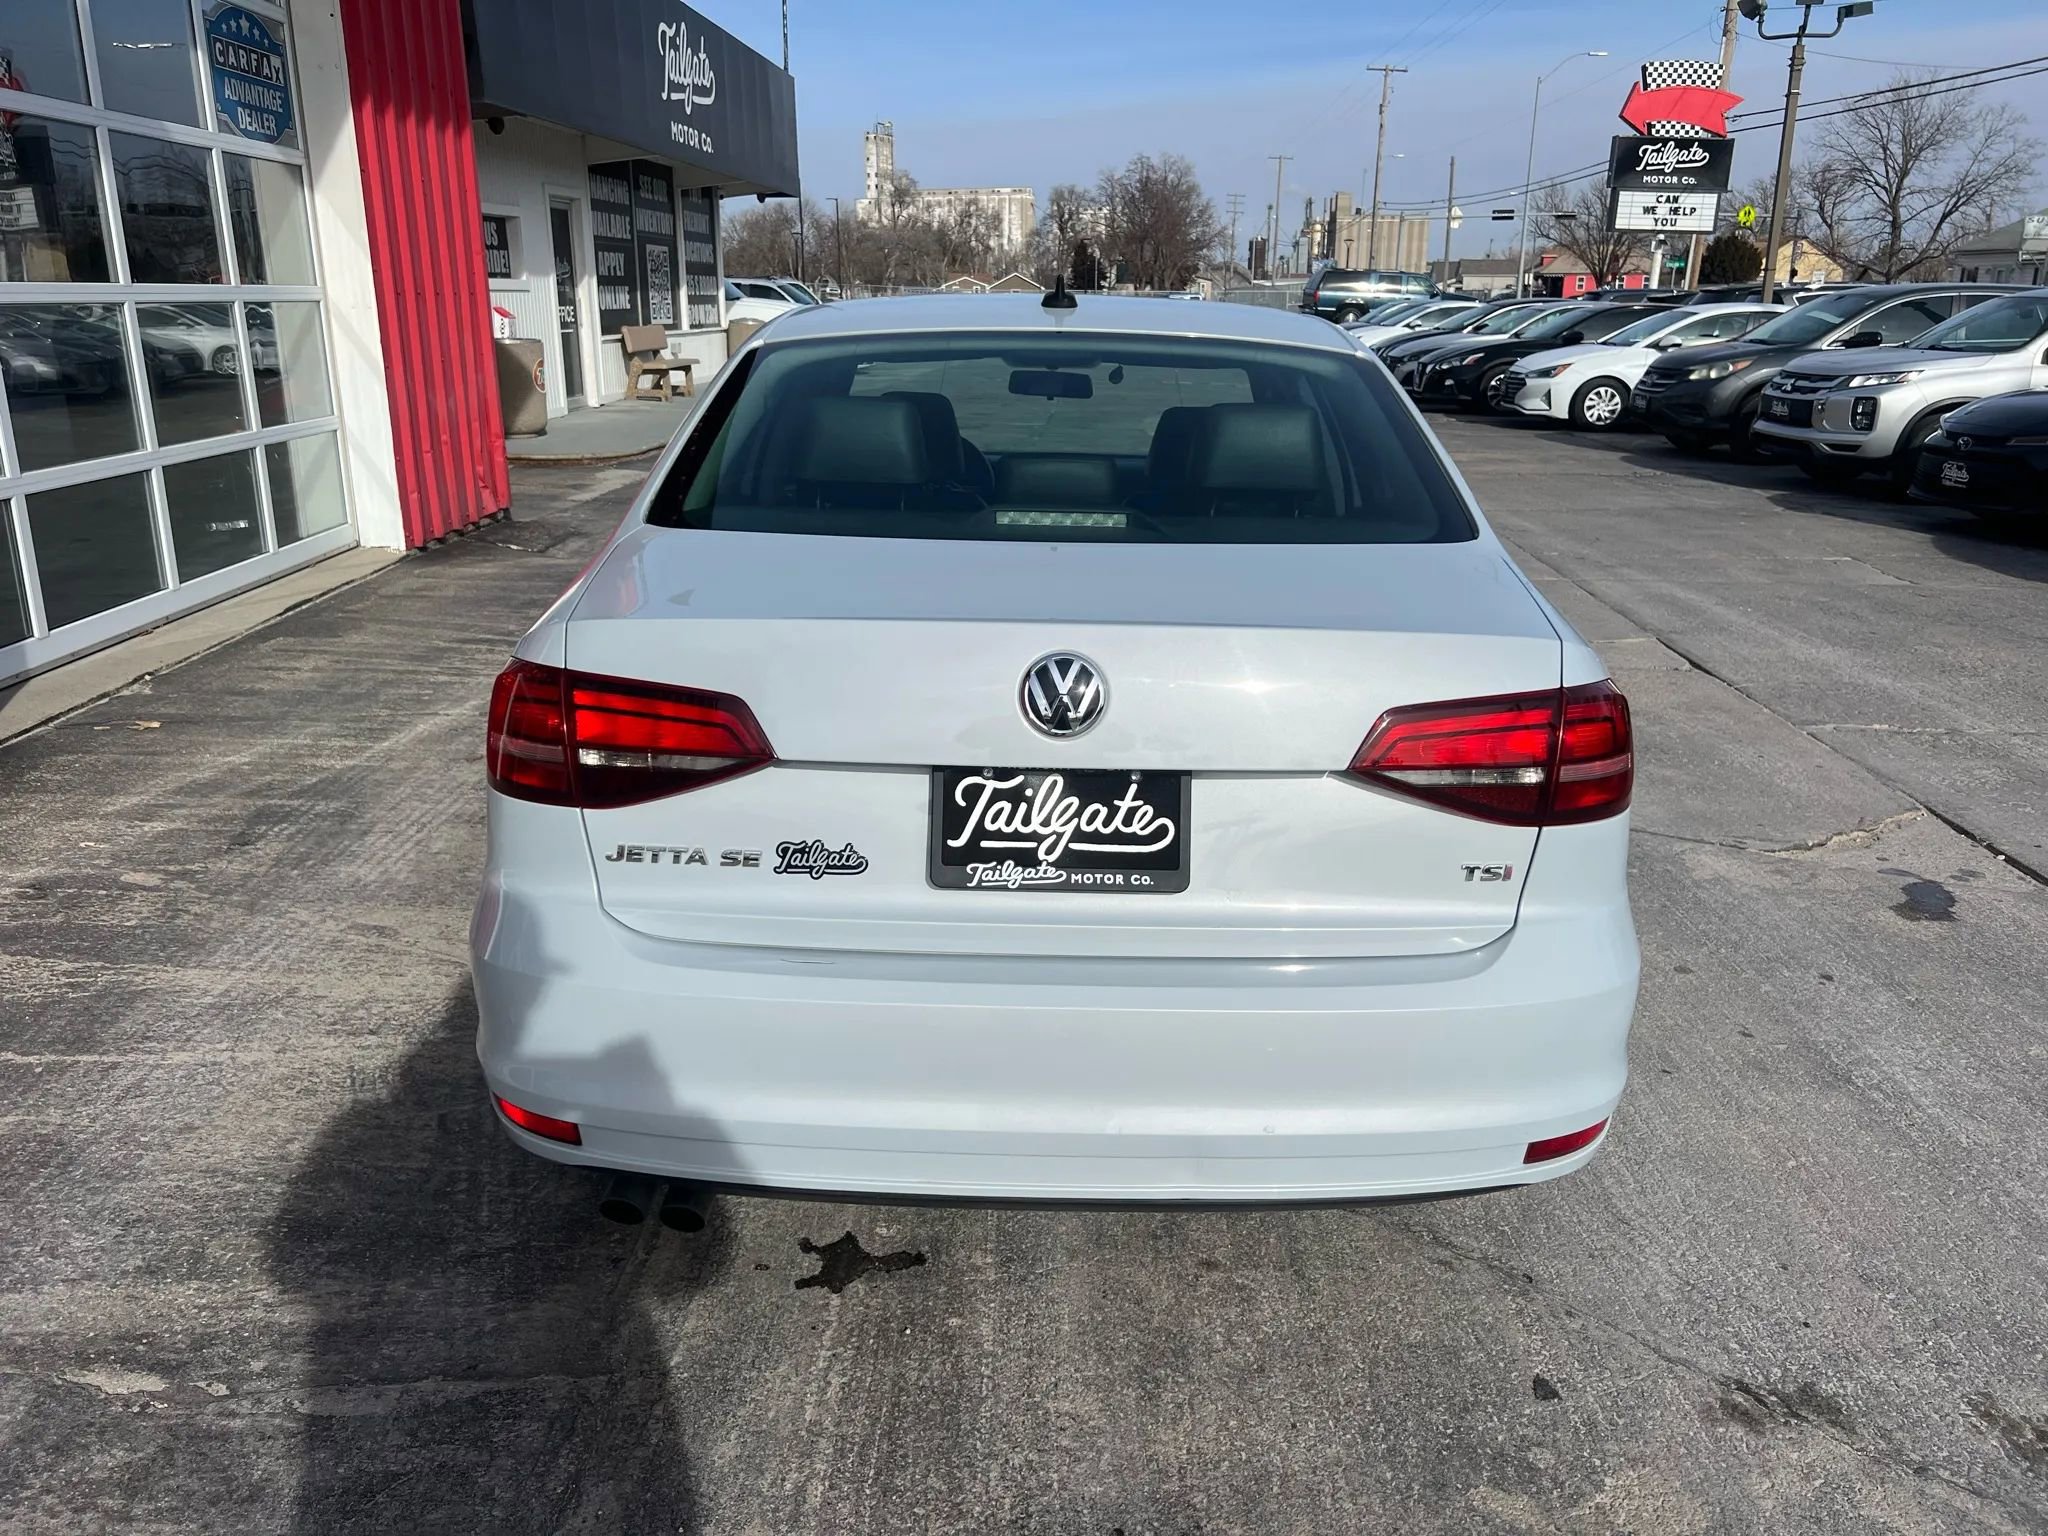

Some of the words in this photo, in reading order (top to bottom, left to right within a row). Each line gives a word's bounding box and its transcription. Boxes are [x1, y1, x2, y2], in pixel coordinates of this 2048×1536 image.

[214, 41, 285, 86] CARFAX
[658, 22, 716, 115] Tailgate
[224, 76, 283, 112] ADVANTAGE
[237, 106, 277, 136] DEALER
[670, 120, 700, 150] MOTOR
[1635, 140, 1709, 173] Tailgate
[653, 176, 668, 203] OUR
[1642, 175, 1678, 184] MOTOR
[1642, 205, 1659, 215] WE
[1668, 206, 1697, 216] HELP
[1656, 194, 1680, 204] CAN
[635, 207, 674, 235] INVENTORY
[1653, 217, 1678, 227] YOU
[598, 251, 625, 277] APPLY
[599, 285, 631, 310] ONLINE
[946, 773, 1176, 862] Tailgate
[604, 844, 712, 866] JETTA
[719, 849, 763, 868] SE
[774, 840, 868, 880] Tailgate
[966, 859, 1067, 889] Tailgate
[1071, 873, 1125, 885] MOTOR
[1460, 863, 1514, 882] TSI
